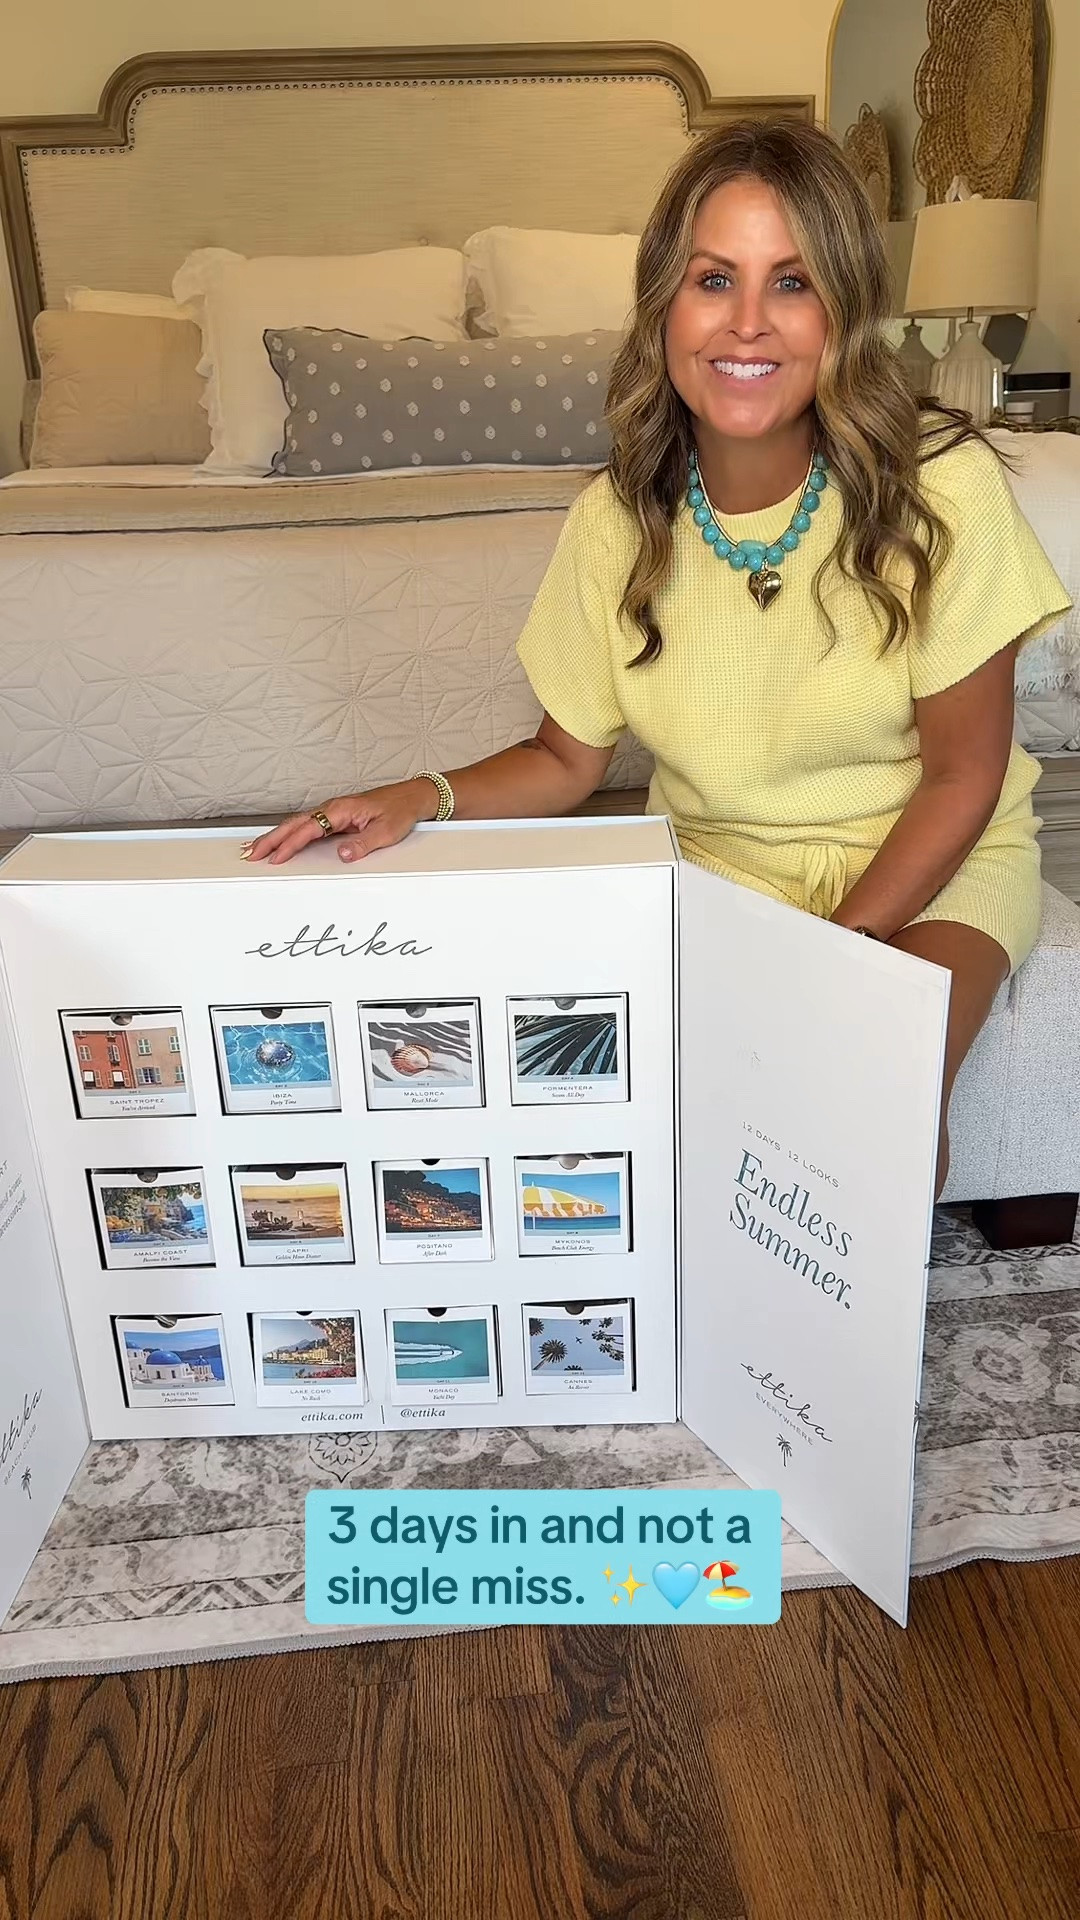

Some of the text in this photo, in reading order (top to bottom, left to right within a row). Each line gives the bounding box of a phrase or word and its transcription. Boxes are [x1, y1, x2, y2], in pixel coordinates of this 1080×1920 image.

[245, 921, 433, 958] ettika
[742, 1121, 840, 1188] 12 DAYS 12 LOOKS
[733, 1148, 853, 1257] Endless
[729, 1192, 852, 1310] Summer.
[0, 1388, 42, 1469] ttika
[301, 1407, 446, 1422] ettika.com @ettika
[741, 1362, 833, 1443] ettika
[755, 1392, 814, 1446] EVERYWHERE
[4, 1423, 37, 1485] BEACH CLUB
